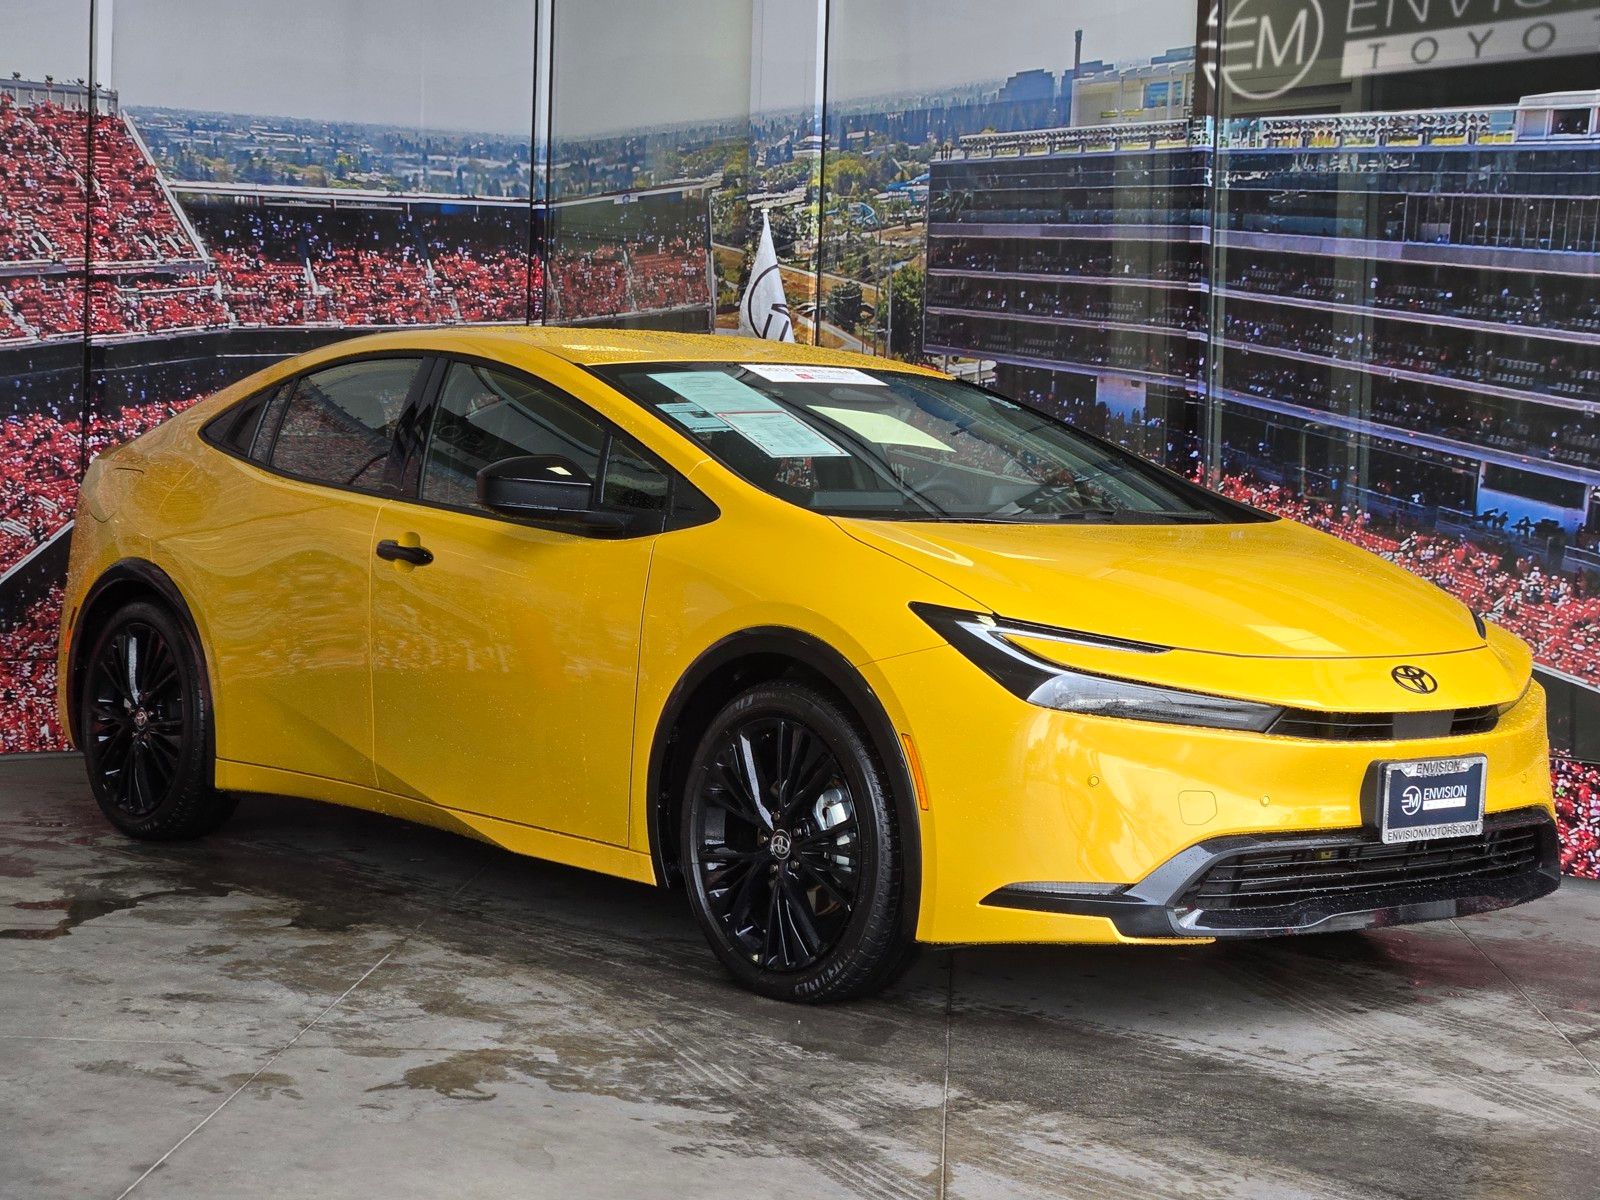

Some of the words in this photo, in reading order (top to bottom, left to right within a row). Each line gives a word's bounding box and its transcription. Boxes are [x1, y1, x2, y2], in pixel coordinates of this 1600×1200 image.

[1367, 14, 1600, 69] TOYO
[1416, 761, 1461, 774] ENVISION
[1423, 785, 1468, 800] ENVISION
[1387, 823, 1478, 841] ENVISIONMOTORS.COM
